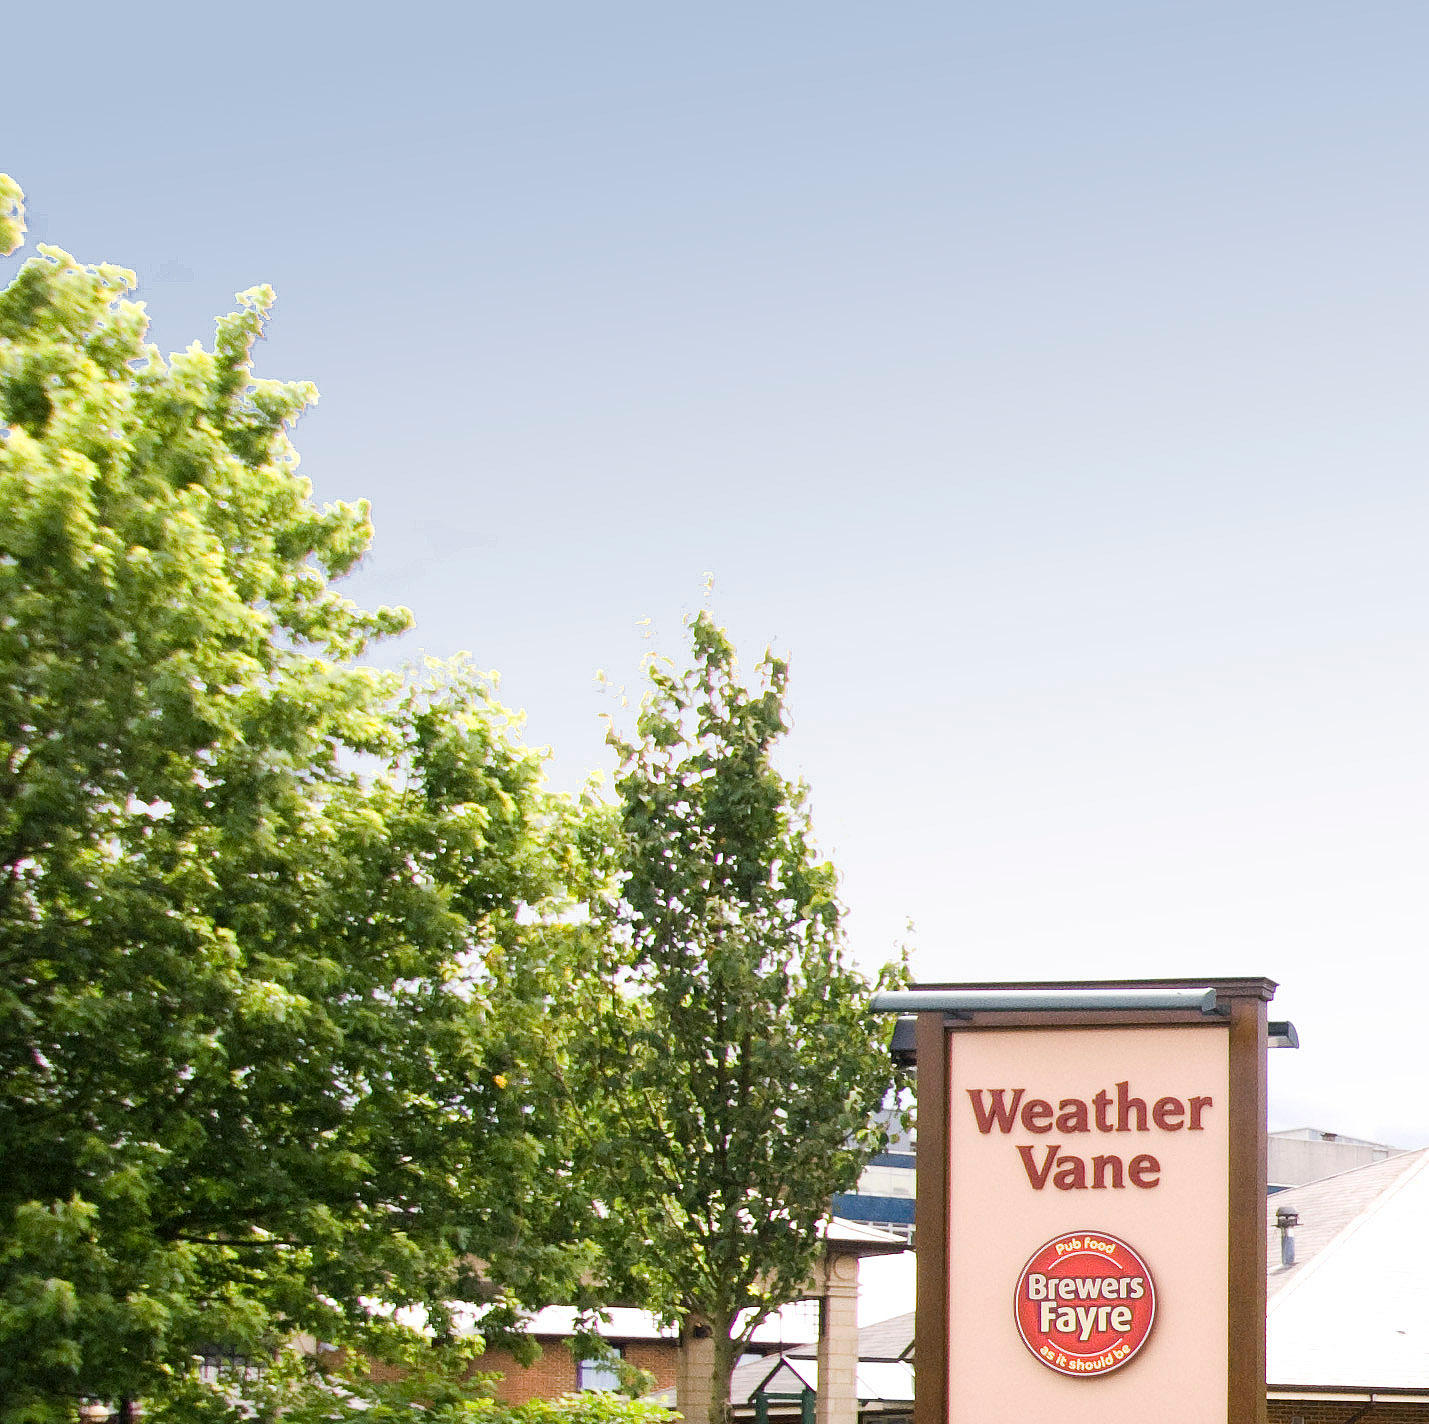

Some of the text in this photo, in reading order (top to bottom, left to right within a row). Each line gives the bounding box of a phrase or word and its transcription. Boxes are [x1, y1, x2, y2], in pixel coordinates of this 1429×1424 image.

[966, 1081, 1214, 1135] Weather
[1015, 1144, 1161, 1191] Vane
[1055, 1237, 1116, 1256] Pub food
[1028, 1273, 1144, 1300] Brewers
[1040, 1301, 1132, 1341] Fayre
[1039, 1344, 1131, 1371] as it should be
